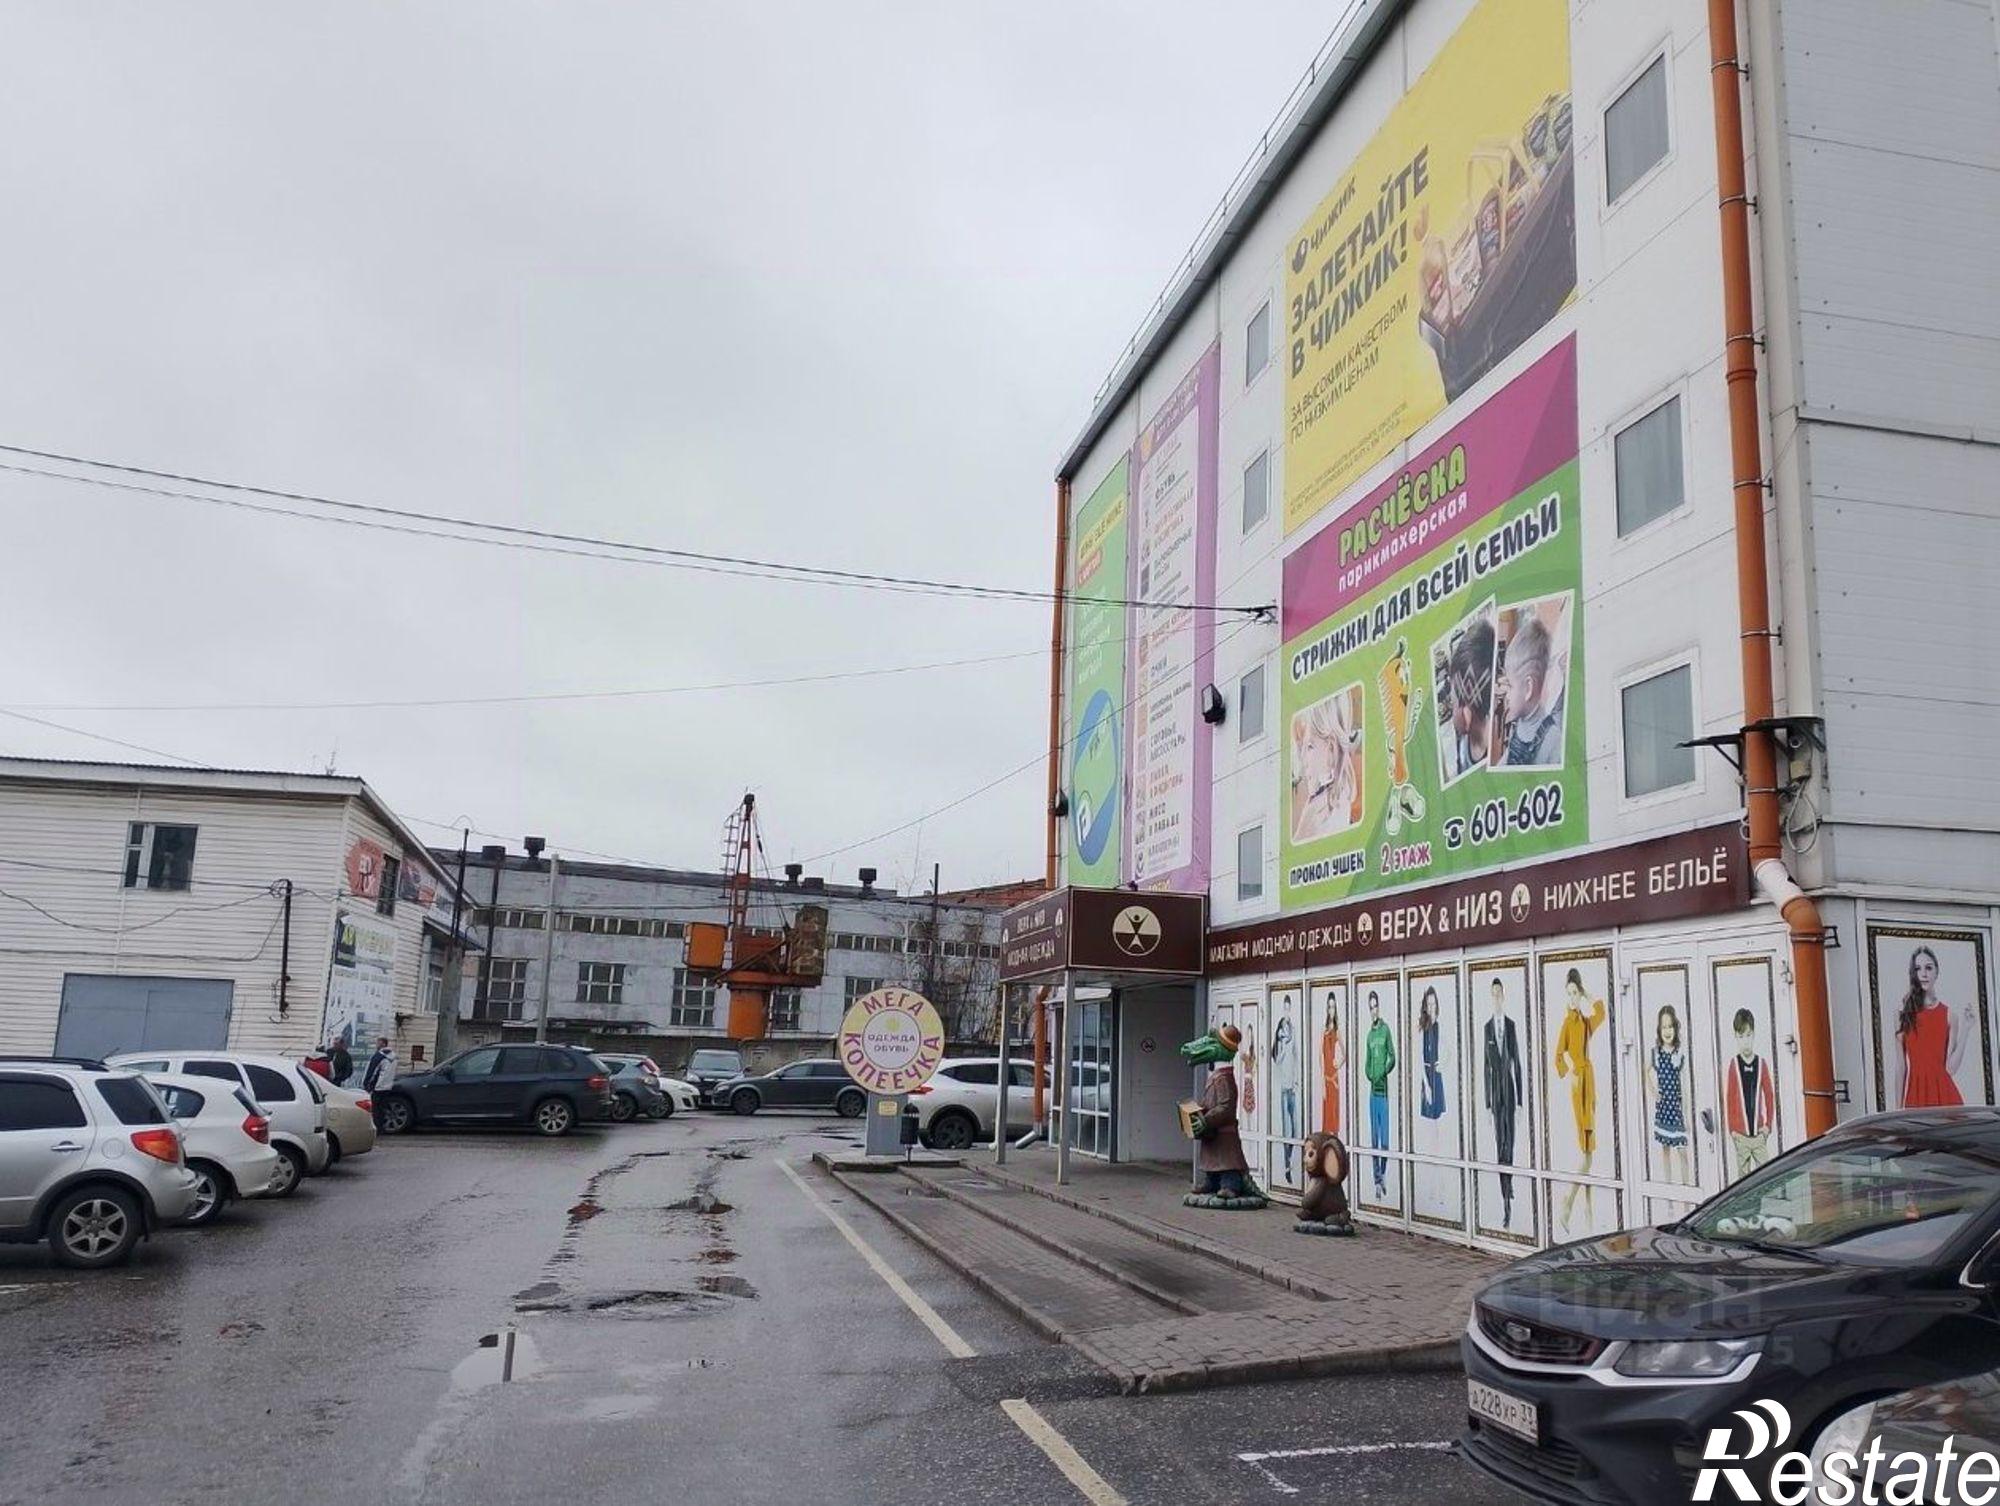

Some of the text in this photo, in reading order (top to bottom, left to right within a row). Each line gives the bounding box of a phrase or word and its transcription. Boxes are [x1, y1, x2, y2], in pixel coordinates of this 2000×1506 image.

[1292, 144, 1429, 334] ЗАЛЕТАЙТЕ
[1292, 337, 1305, 379] В
[1310, 219, 1408, 351] ЧИЖИК!
[1347, 293, 1408, 364] КАЧЕСТВОМ
[1344, 347, 1379, 392] ЦЕНАМ
[1338, 444, 1467, 567] РАСЧЁСКА
[1338, 491, 1468, 593] парикмахерская
[1292, 500, 1559, 681] СТРИЖКИ ДЛЯ ВСЕЙ СЕМЬИ
[1470, 788, 1563, 845] 601-602
[1290, 852, 1365, 886] ПРОКОЛ УШЕК
[1381, 842, 1431, 872] 2 ЭТАЖ
[1251, 930, 1296, 957] МОДНОЙ
[1299, 922, 1352, 951] ОДЕЖДЫ
[1380, 903, 1433, 942] ВЕРХ
[1438, 906, 1450, 933] &
[1455, 889, 1503, 930] НИЗ
[1543, 870, 1636, 911] НИЖНЕЕ
[1649, 846, 1728, 895] БЕЛЬЁ
[862, 991, 924, 1016] МЕГА
[844, 1032, 940, 1089] КОПЕЕЧКА
[868, 1034, 915, 1043] ОДЕЖДА
[874, 1044, 909, 1053] ОБУВЬ
